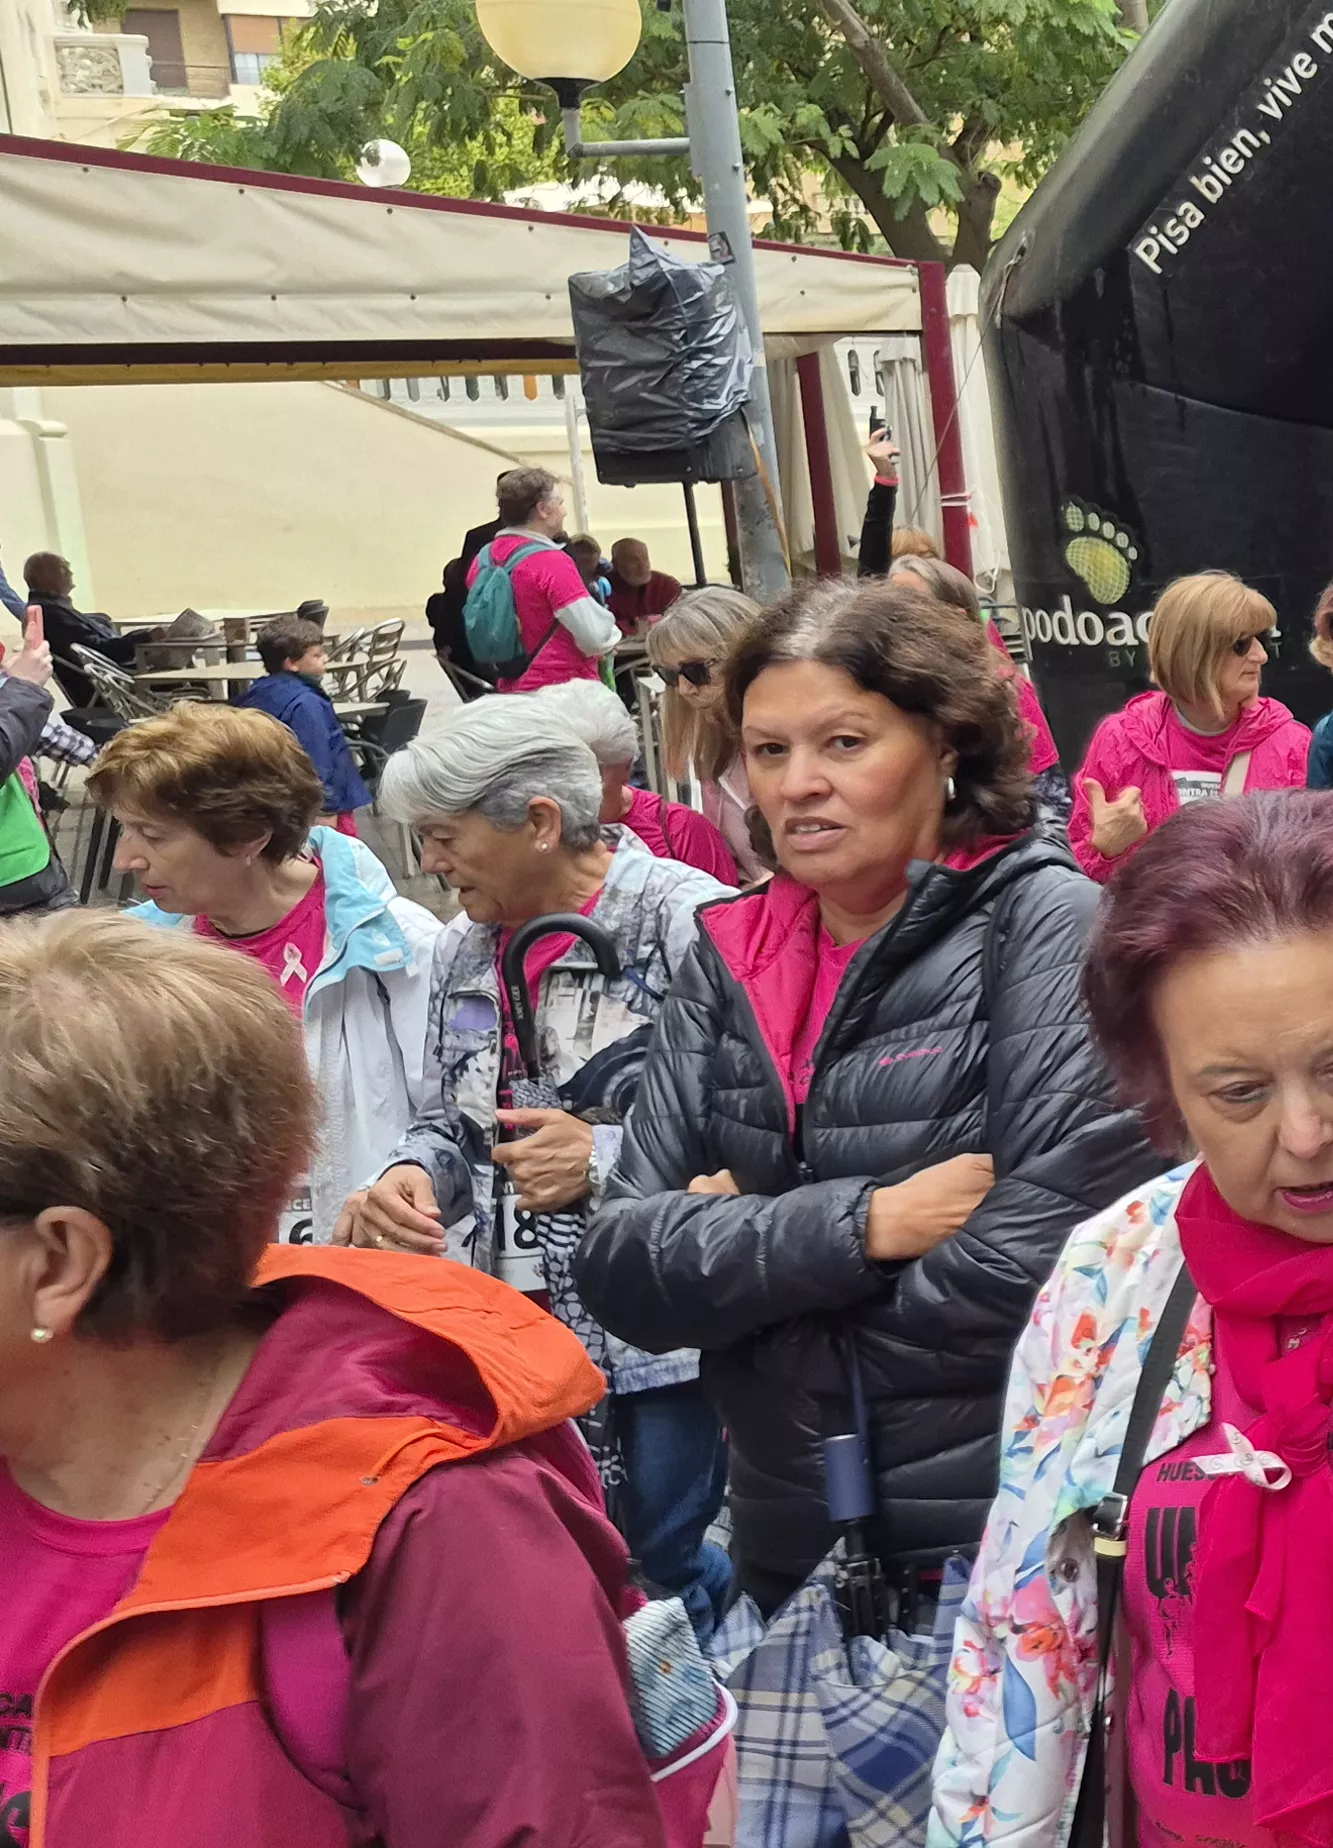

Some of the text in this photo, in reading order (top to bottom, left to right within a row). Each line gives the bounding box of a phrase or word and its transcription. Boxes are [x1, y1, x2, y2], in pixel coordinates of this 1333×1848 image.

[1135, 201, 1205, 274] Pisa
[1190, 128, 1271, 204] bien,
[1257, 52, 1318, 121] vive
[1109, 652, 1137, 668] BY
[1156, 1462, 1216, 1482] HUES
